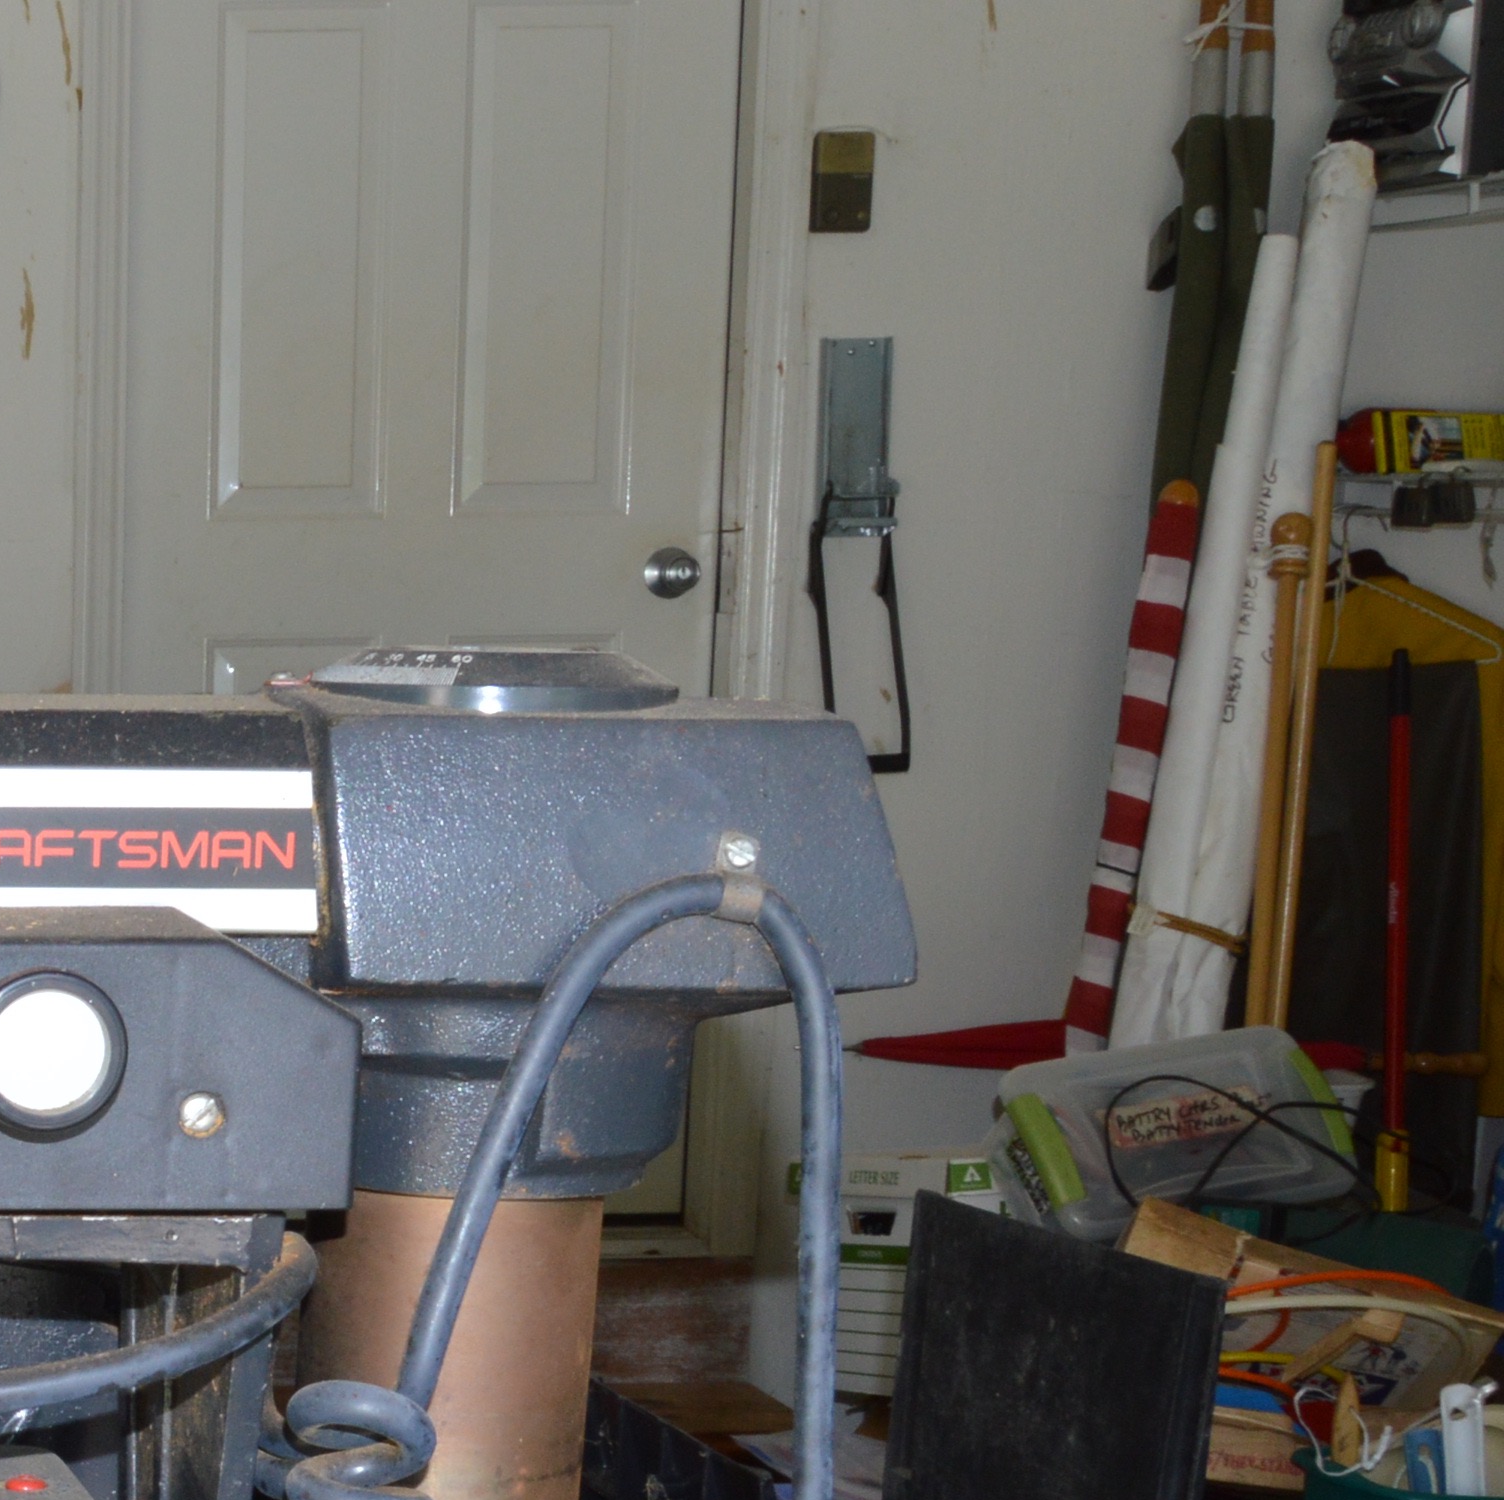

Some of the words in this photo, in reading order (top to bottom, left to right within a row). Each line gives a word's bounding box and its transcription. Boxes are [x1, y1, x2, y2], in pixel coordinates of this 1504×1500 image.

[417, 654, 437, 662] 45
[451, 655, 473, 663] 60
[849, 1171, 878, 1185] LETTER
[881, 1171, 900, 1185] SIZE
